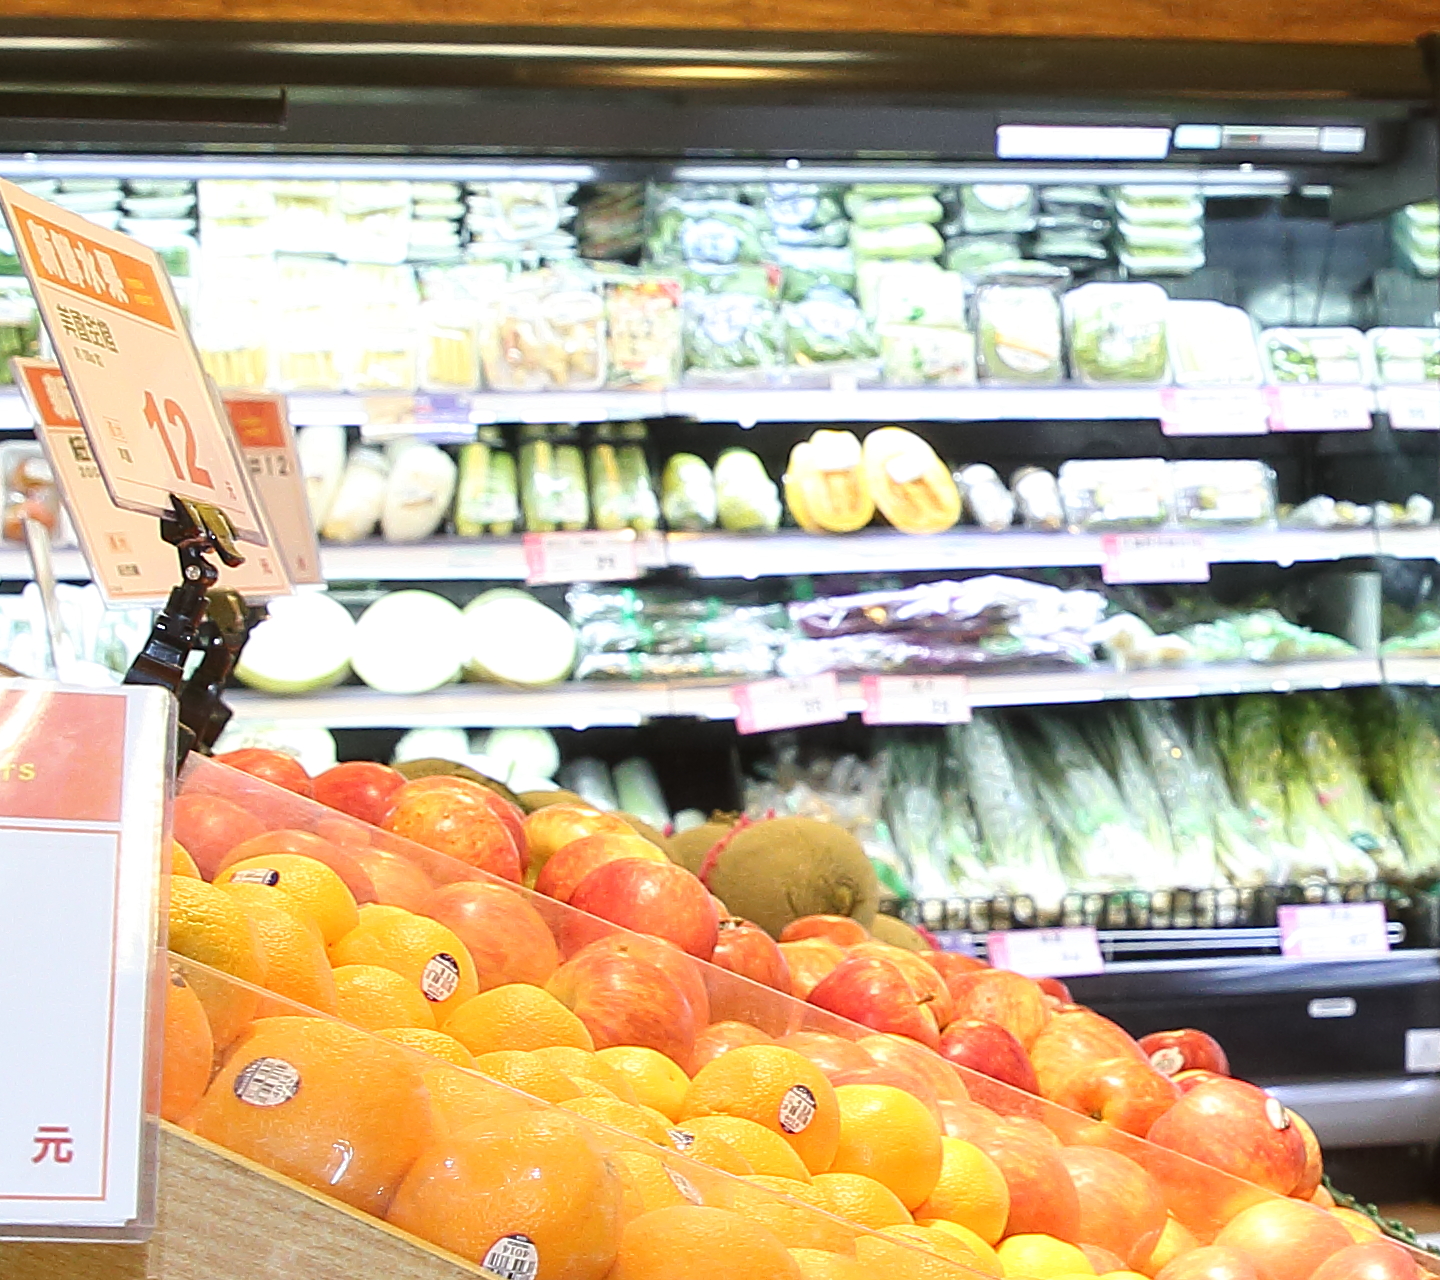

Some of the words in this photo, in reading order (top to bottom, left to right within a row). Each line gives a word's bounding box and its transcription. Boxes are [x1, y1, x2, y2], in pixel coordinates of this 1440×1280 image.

[143, 389, 216, 490] 12
[31, 1126, 74, 1165] 元
[502, 1244, 530, 1259] 4014
